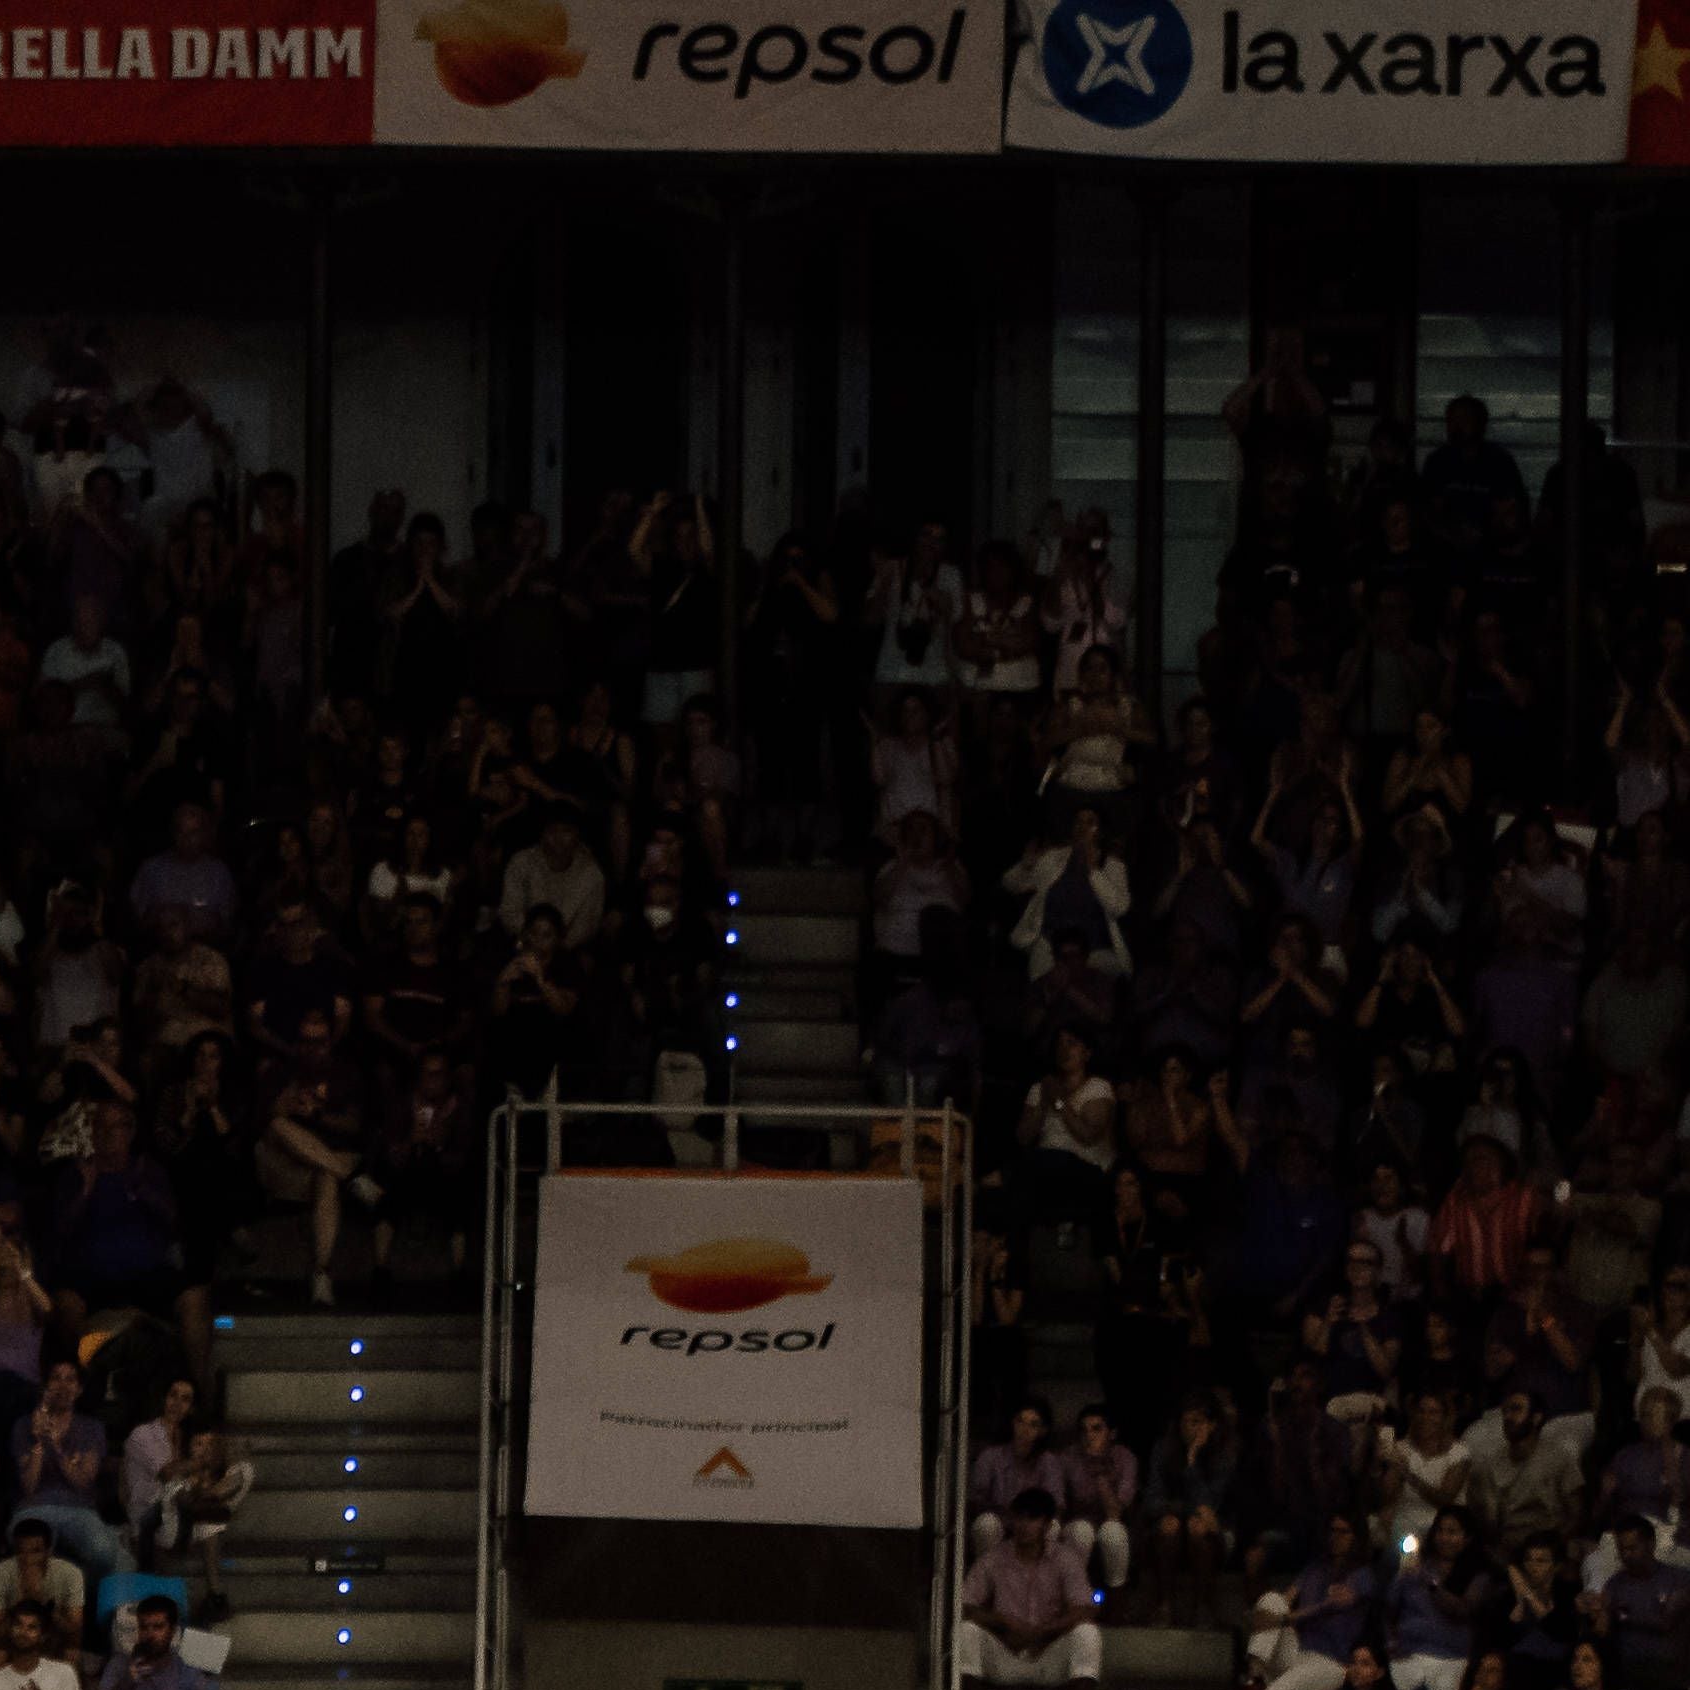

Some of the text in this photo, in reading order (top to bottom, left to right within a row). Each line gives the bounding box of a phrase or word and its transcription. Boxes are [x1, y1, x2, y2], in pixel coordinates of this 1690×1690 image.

[171, 27, 363, 79] DAMM
[632, 8, 967, 100] repsol
[620, 1322, 836, 1357] repsol
